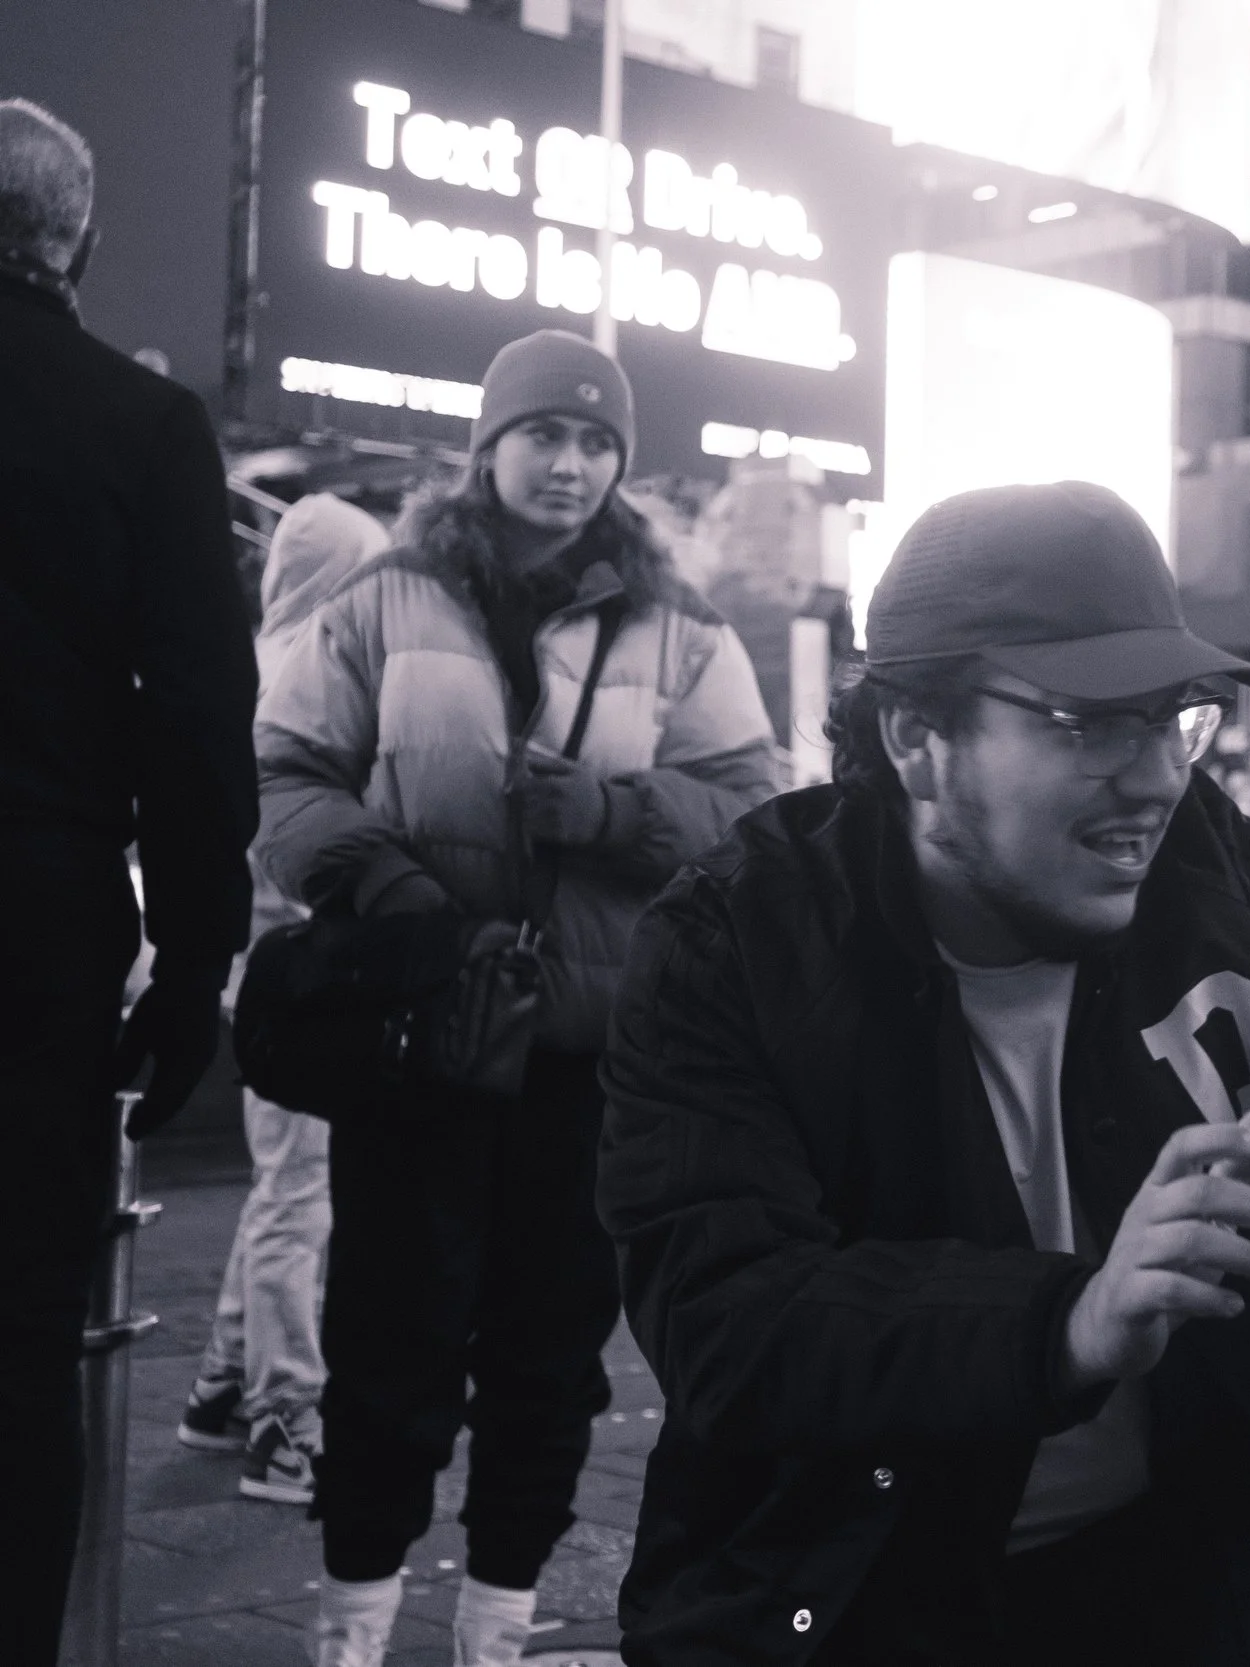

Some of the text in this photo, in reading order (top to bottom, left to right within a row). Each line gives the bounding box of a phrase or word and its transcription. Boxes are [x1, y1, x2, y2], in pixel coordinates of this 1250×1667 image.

[354, 82, 824, 260] Text OR Drive.
[313, 180, 528, 300] There
[608, 241, 701, 332] No
[702, 262, 857, 371] AND.
